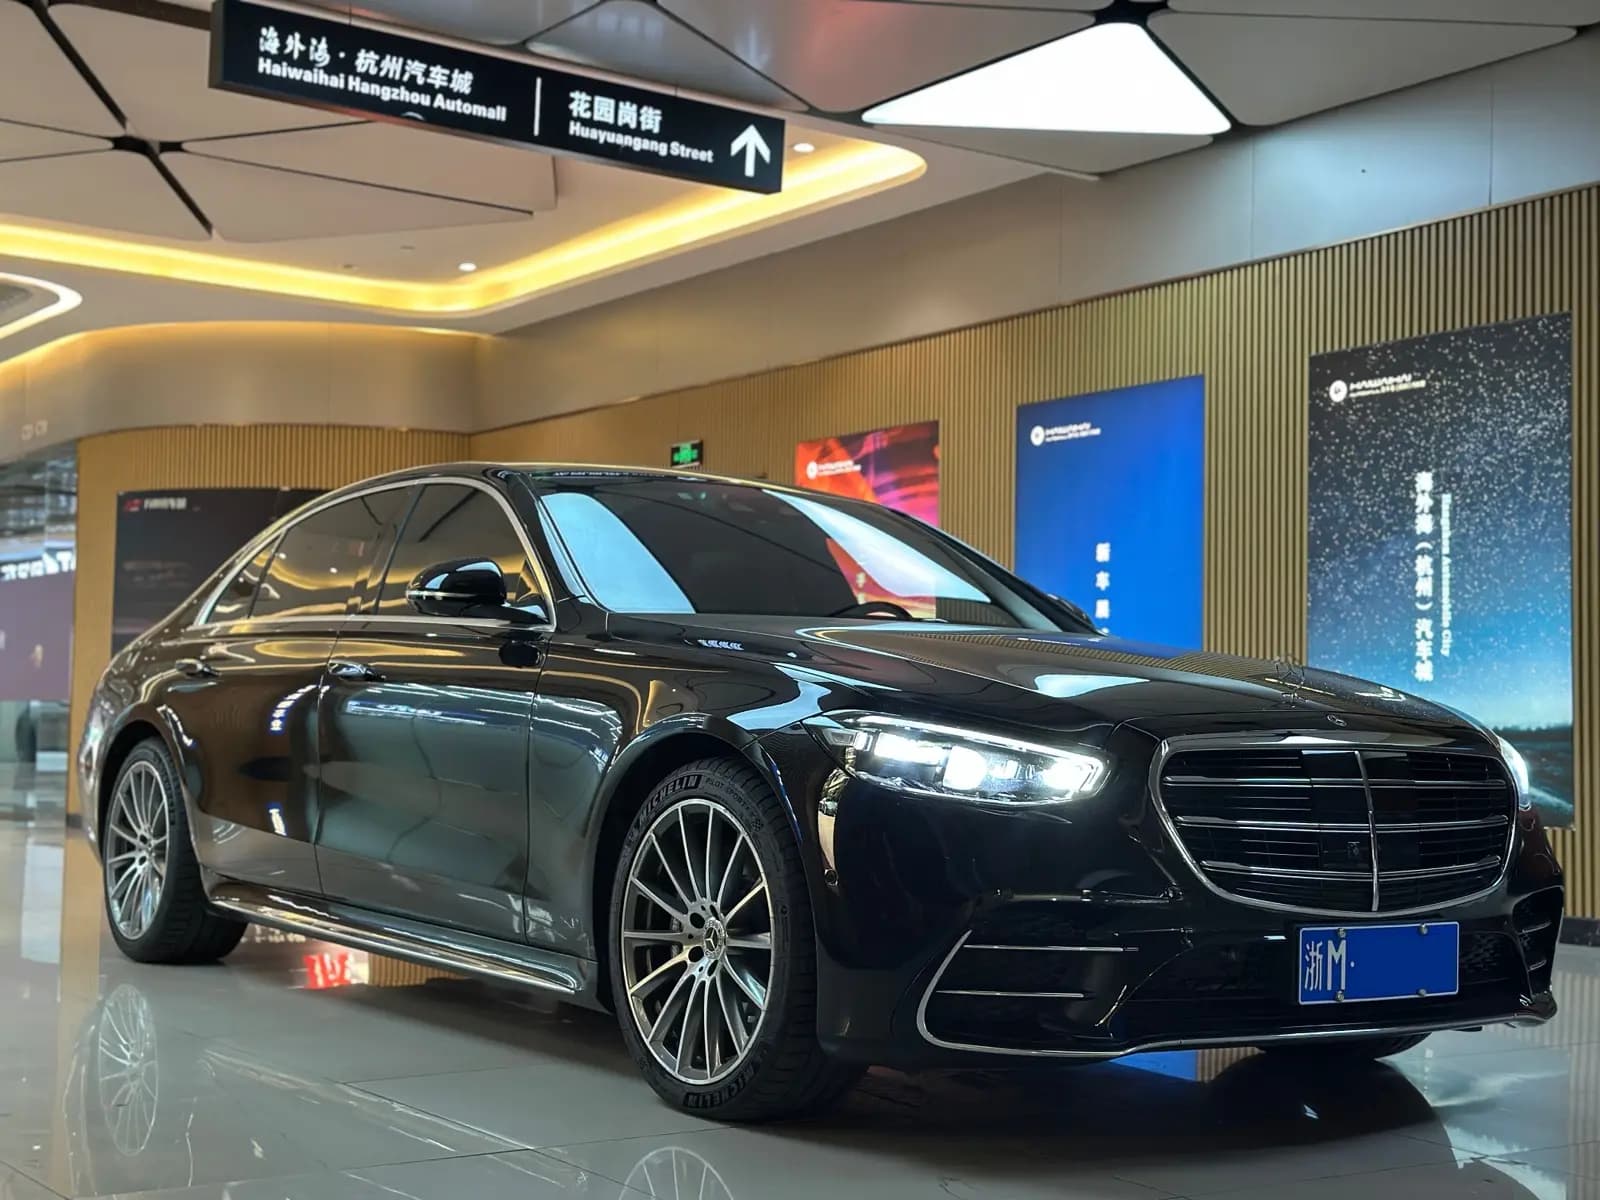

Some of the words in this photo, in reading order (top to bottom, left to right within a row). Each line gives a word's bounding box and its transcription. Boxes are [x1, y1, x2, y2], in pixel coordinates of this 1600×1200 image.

[258, 56, 345, 89] Haiwaihai
[347, 75, 431, 107] Hangzhou
[433, 93, 507, 122] Automall
[568, 90, 662, 134] 花园岗街
[568, 120, 668, 157] Huayuangang
[669, 141, 714, 163] Street
[639, 775, 699, 825] MICHELIN
